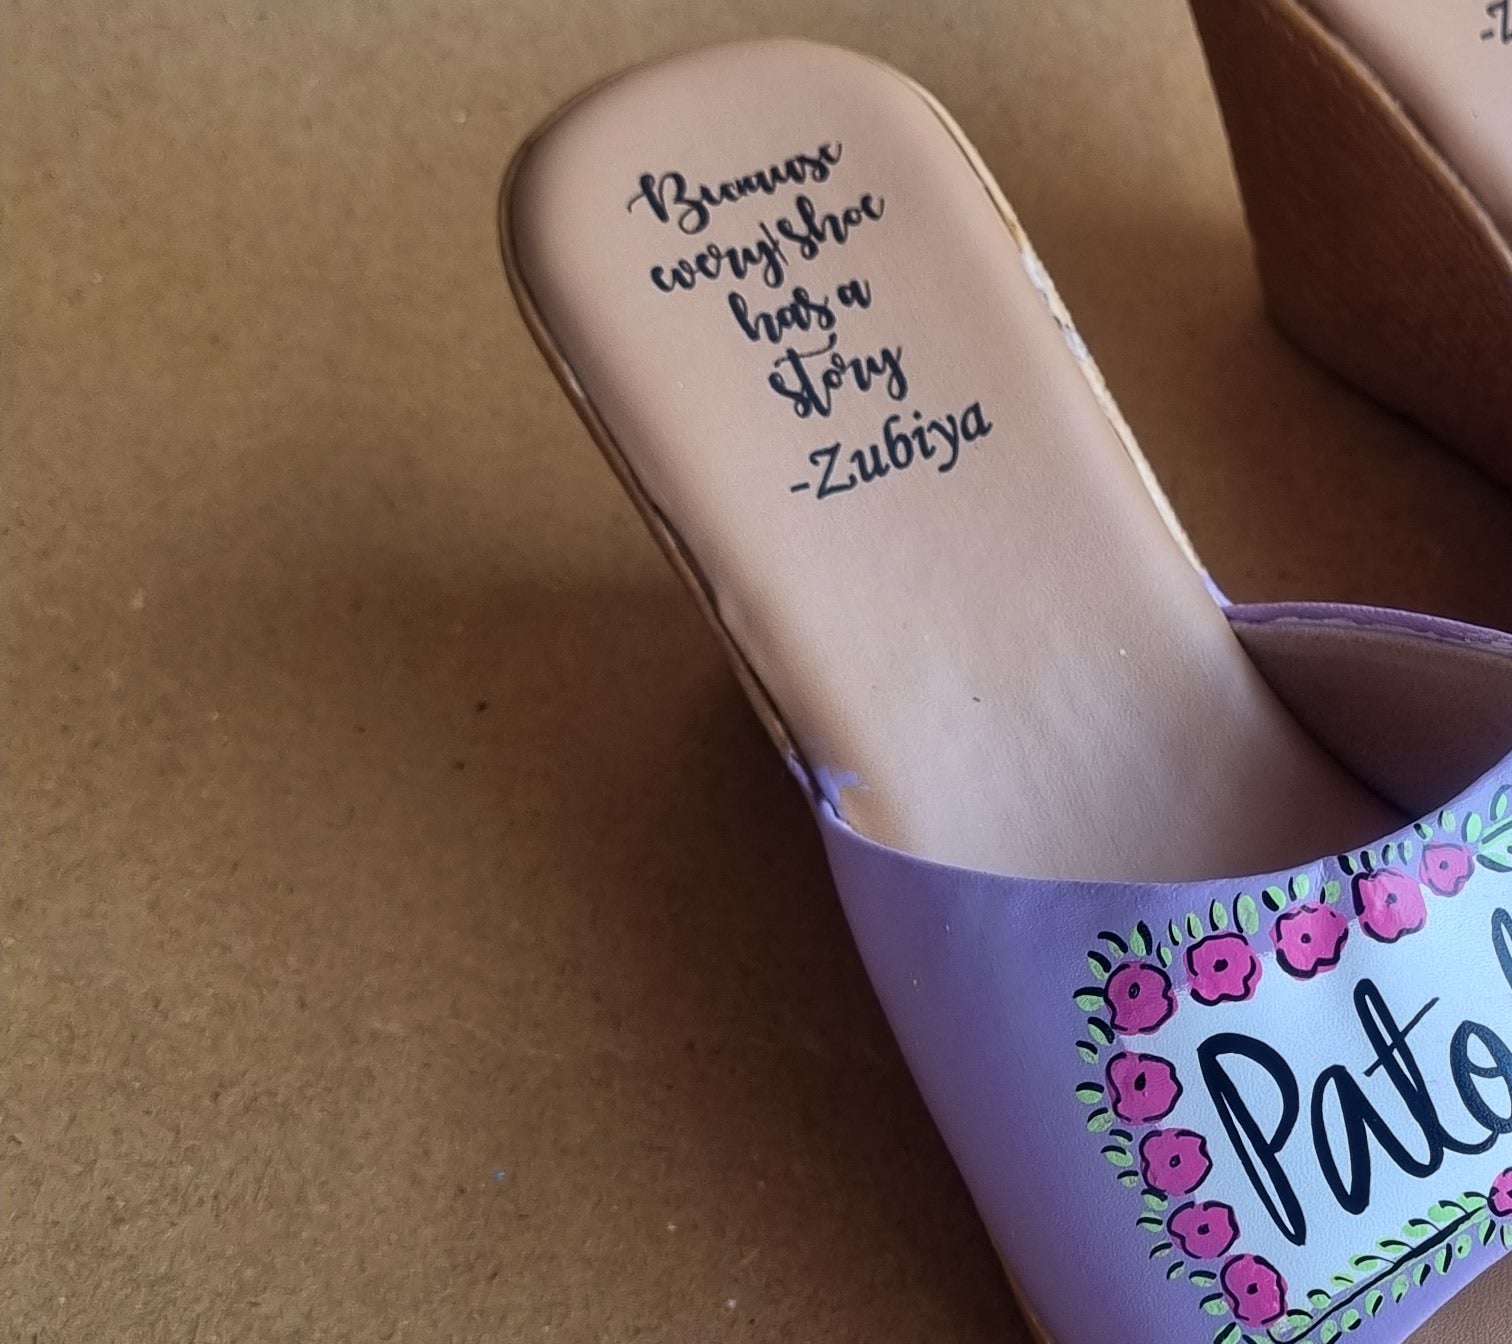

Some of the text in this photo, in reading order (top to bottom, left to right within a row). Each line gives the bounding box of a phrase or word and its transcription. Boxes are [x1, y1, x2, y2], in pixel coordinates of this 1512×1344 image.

[728, 278, 872, 344] has a
[790, 401, 993, 500] -Zubiya
